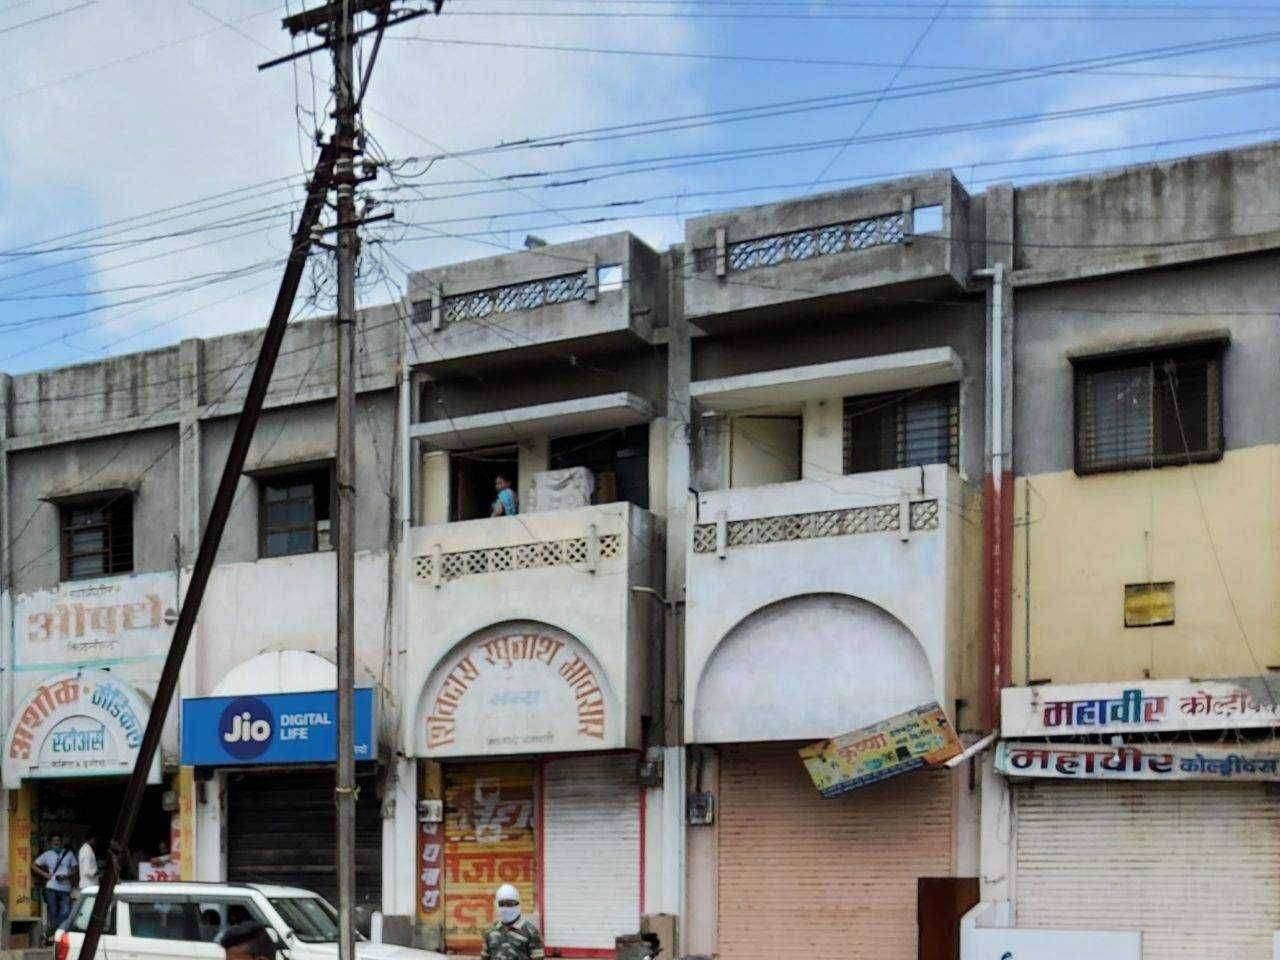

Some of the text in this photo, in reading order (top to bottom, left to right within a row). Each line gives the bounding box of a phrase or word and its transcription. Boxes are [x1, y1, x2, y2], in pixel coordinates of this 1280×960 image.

[280, 712, 333, 727] DIGITAL
[1043, 689, 1168, 728] महावीर
[224, 712, 271, 742] Jio
[280, 728, 308, 741] LIFE
